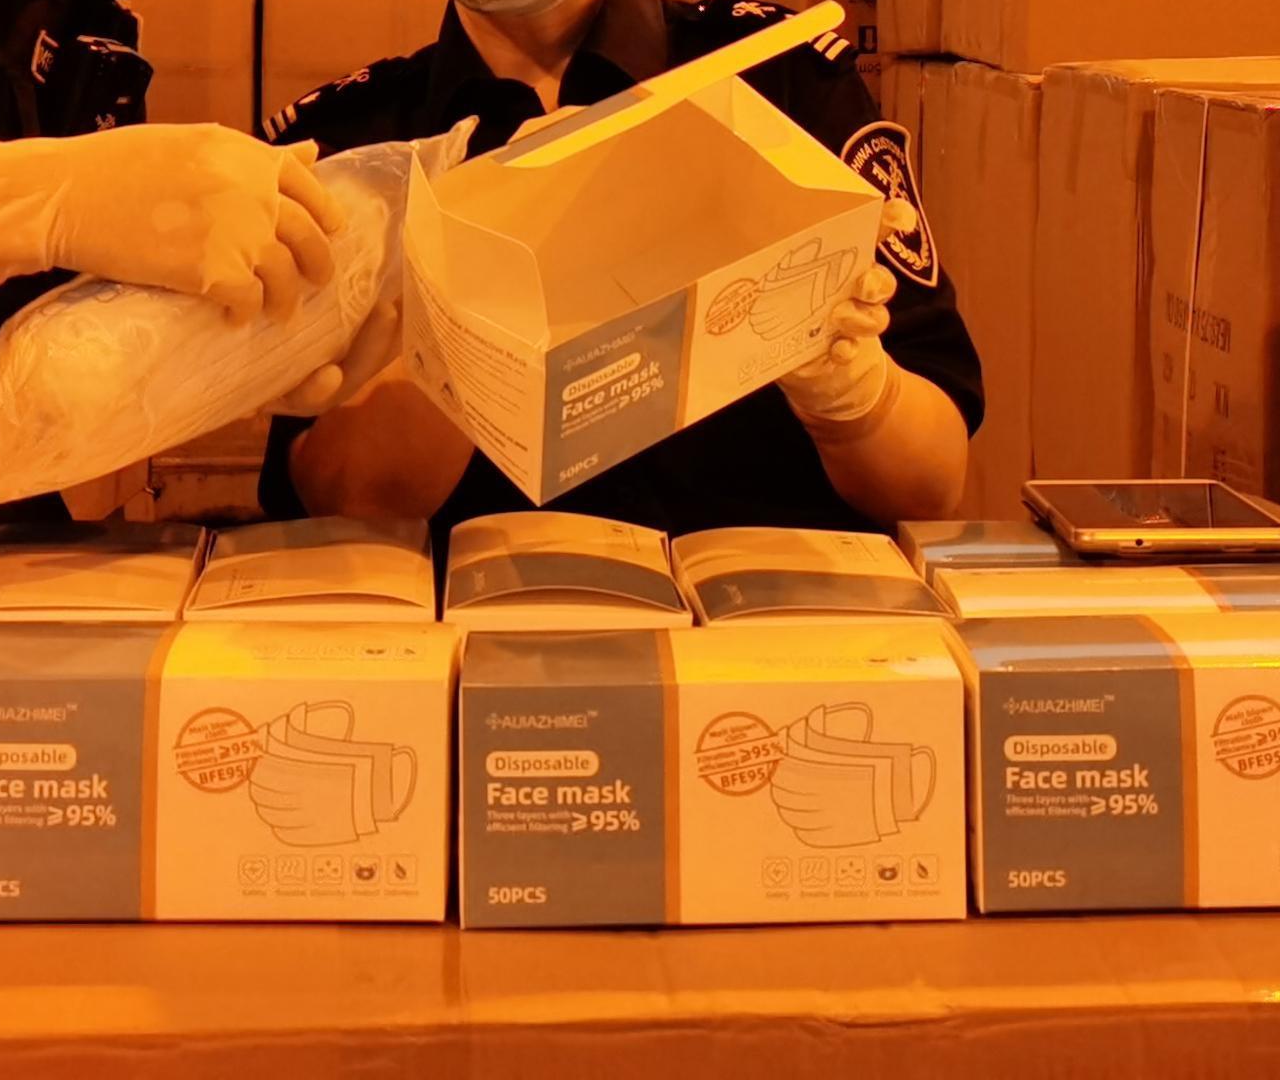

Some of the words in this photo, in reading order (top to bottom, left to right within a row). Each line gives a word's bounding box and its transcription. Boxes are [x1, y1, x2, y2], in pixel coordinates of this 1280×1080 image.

[850, 142, 873, 174] HINA
[562, 391, 606, 421] Face
[609, 361, 661, 397] mask
[1013, 739, 1108, 757] Disposable
[495, 756, 590, 773] Disposable
[33, 773, 108, 799] mask
[721, 768, 765, 787] BFE95
[1006, 767, 1067, 789] Face
[1076, 763, 1149, 789] mask
[487, 783, 549, 805] Face
[557, 779, 631, 804] mask
[1007, 871, 1066, 889] 50PCS
[488, 887, 547, 905] 50PCS
